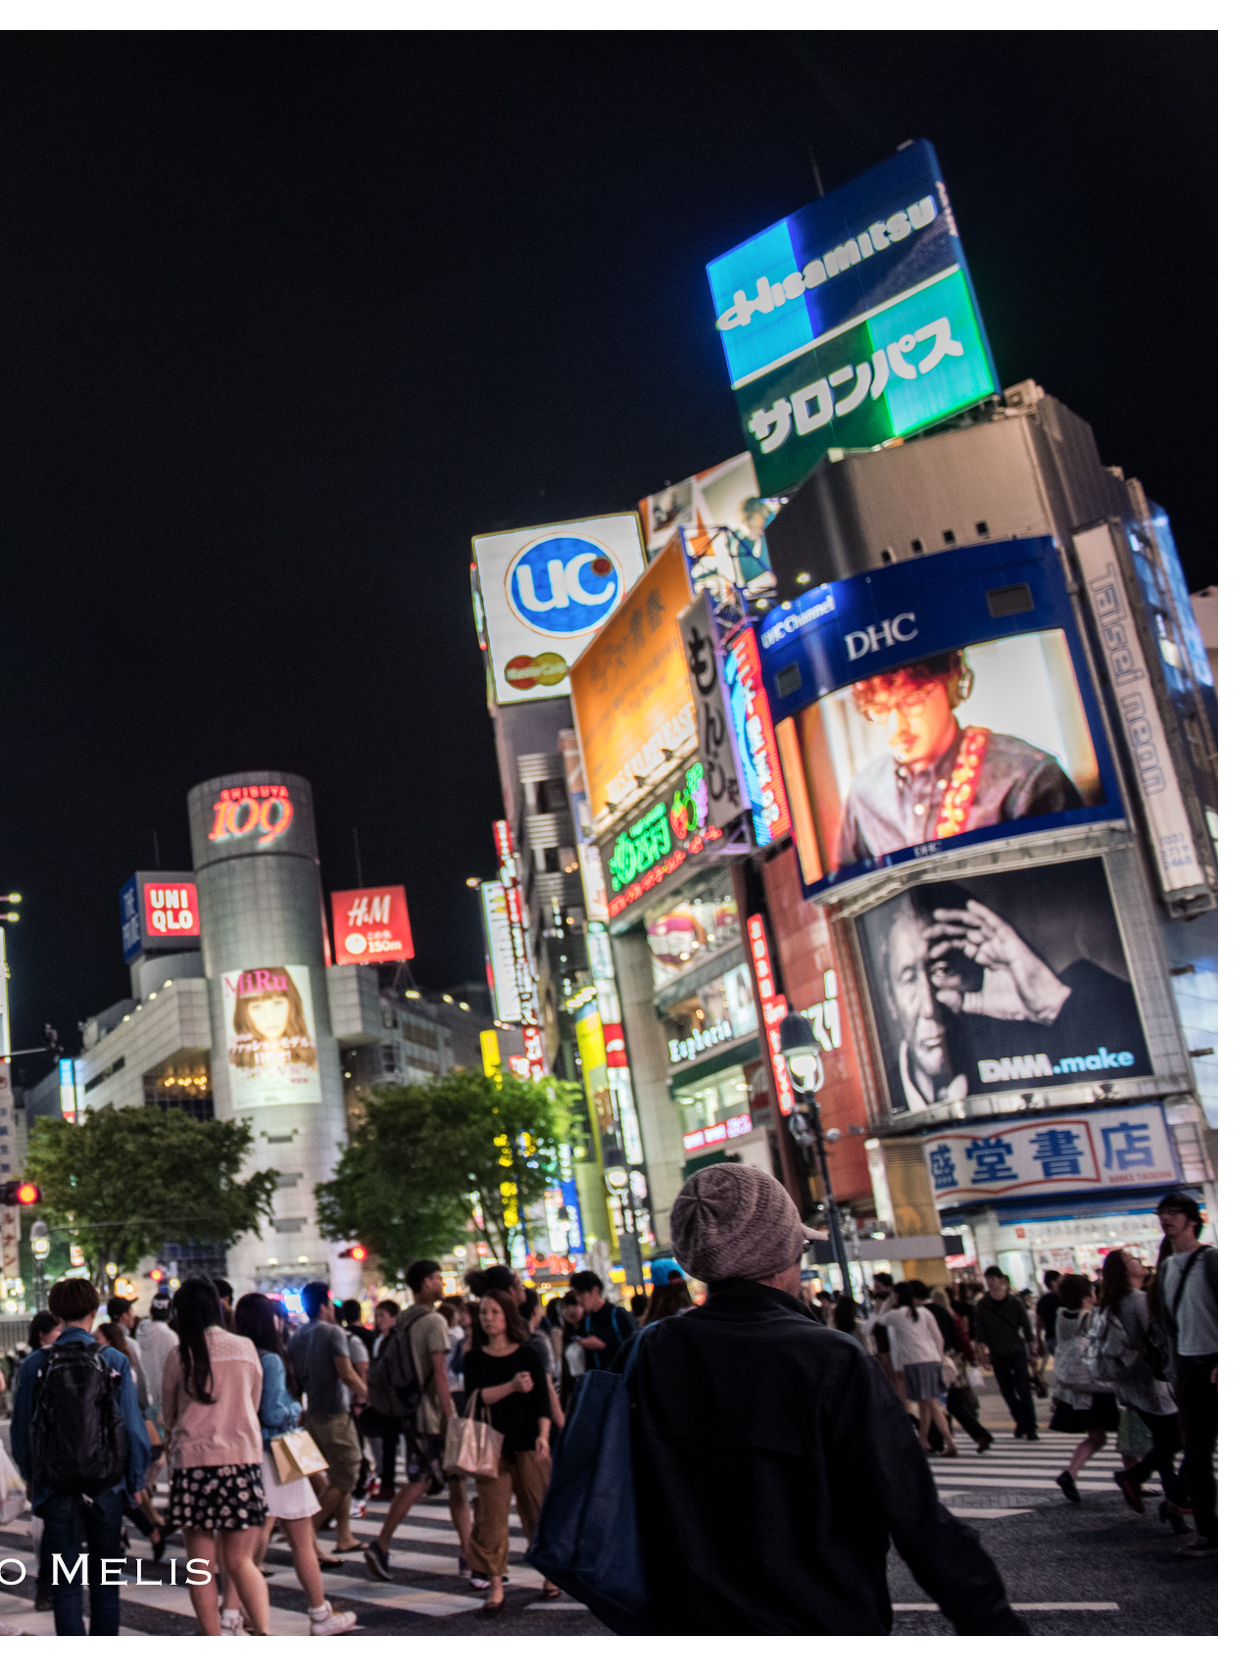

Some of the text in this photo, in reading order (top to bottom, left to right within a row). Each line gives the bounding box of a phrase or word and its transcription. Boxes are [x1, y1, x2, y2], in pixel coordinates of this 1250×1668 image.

[748, 316, 964, 454] サロンパス
[844, 612, 919, 661] DHC
[220, 785, 289, 800] SHIBUYA
[208, 797, 294, 844] 109
[913, 843, 943, 858] DHC
[150, 889, 188, 909] UNI
[347, 894, 391, 927] H&M
[152, 909, 193, 932] QLO
[368, 940, 402, 953] 150m
[668, 1020, 732, 1062] Euphoria
[978, 1047, 1134, 1083] DMM.make
